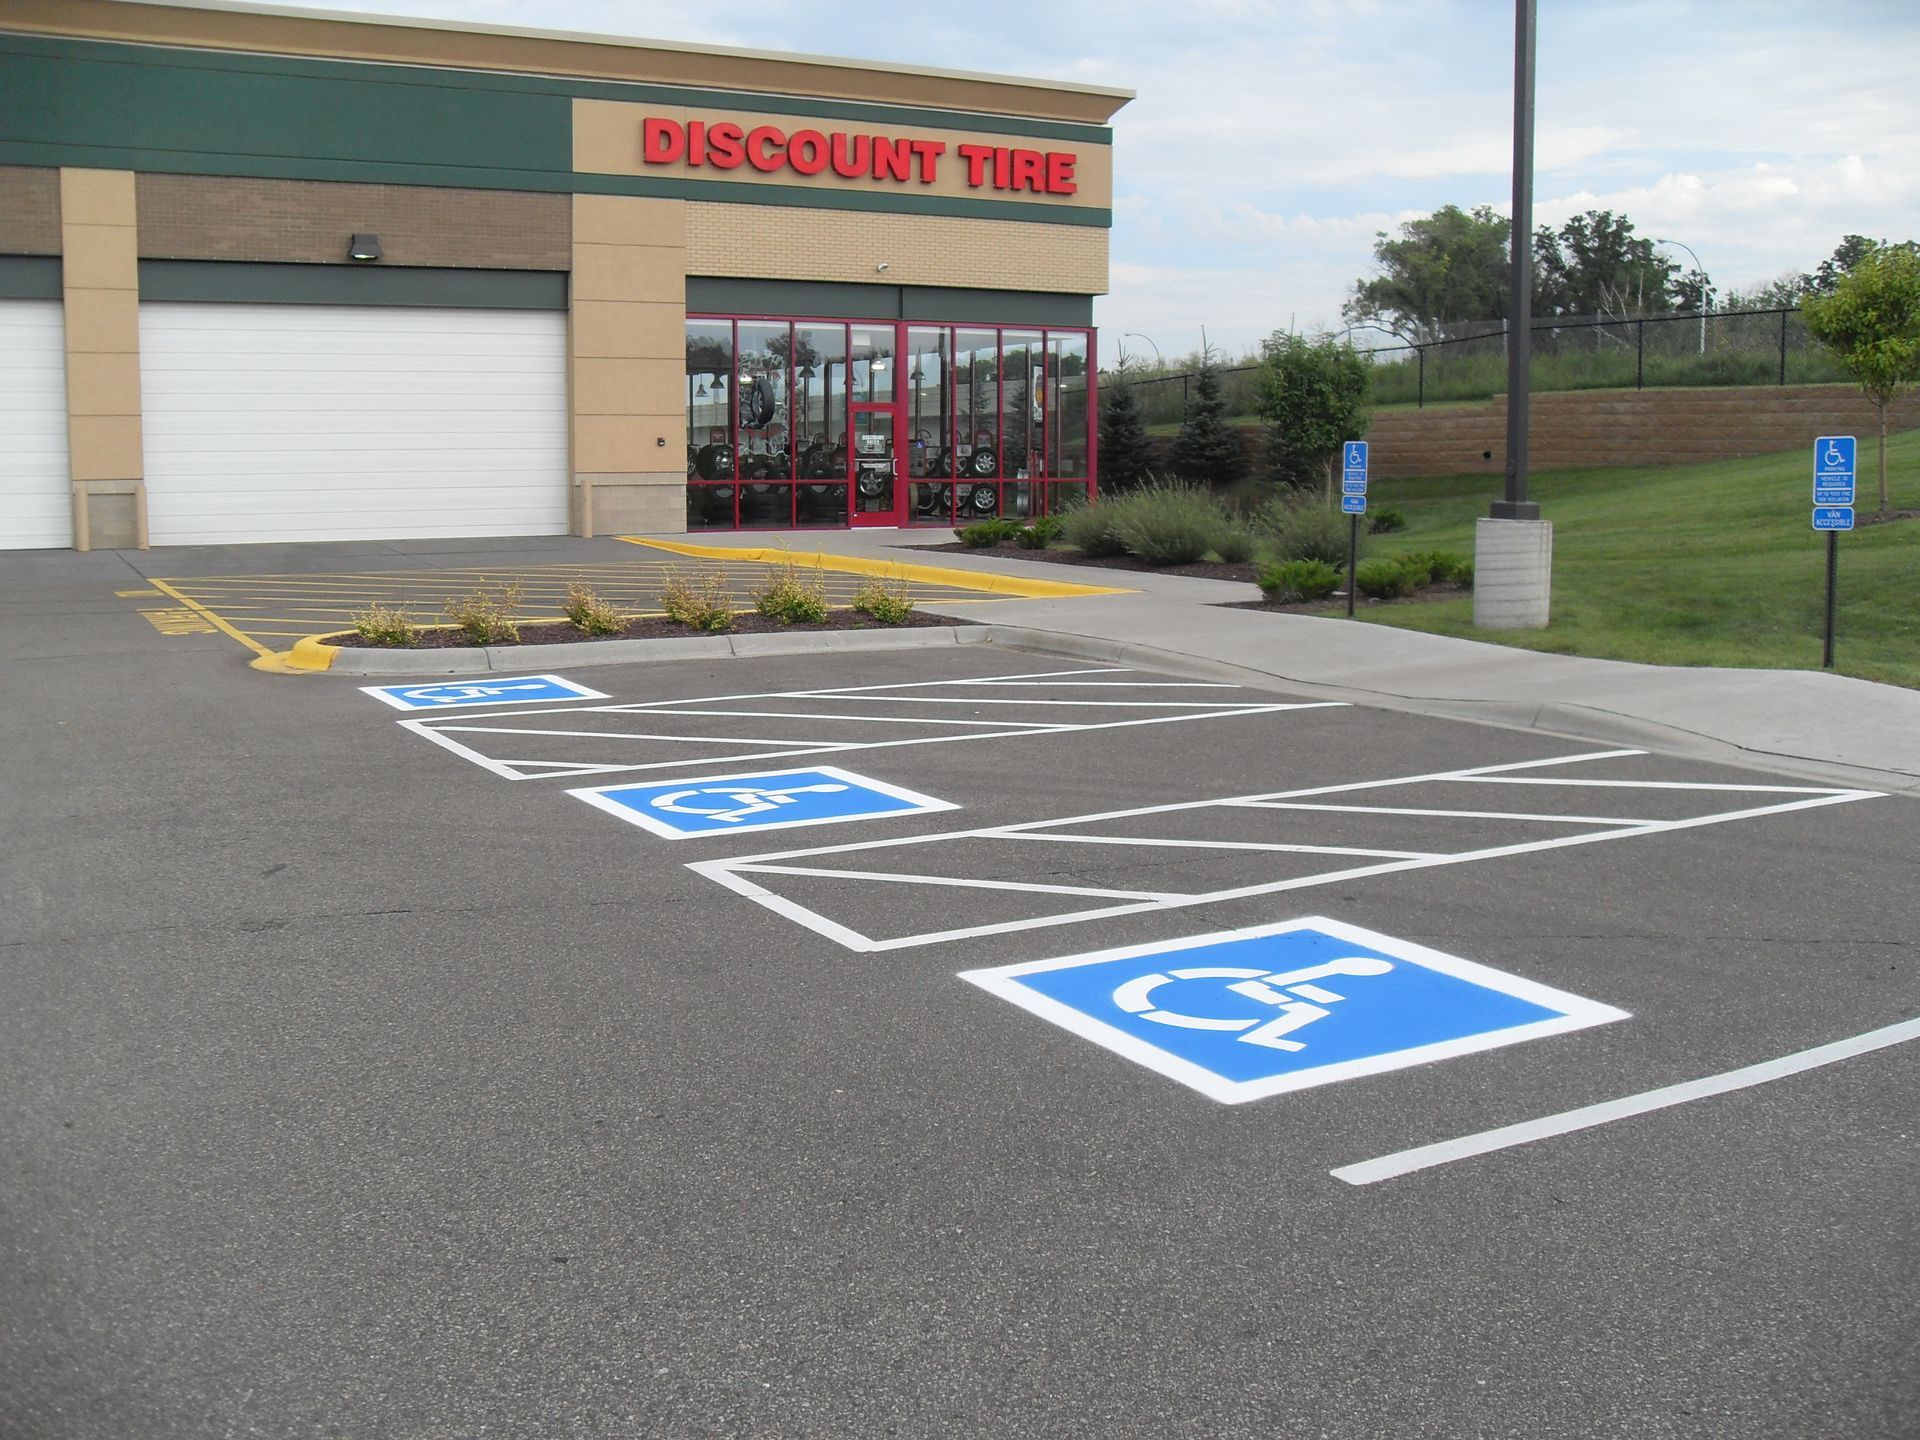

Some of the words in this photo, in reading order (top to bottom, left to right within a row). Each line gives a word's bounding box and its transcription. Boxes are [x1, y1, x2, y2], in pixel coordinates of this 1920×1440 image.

[643, 117, 946, 184] DISCOUNT
[958, 143, 1078, 194] TIRE
[1816, 518, 1851, 526] ACCESSIBLE
